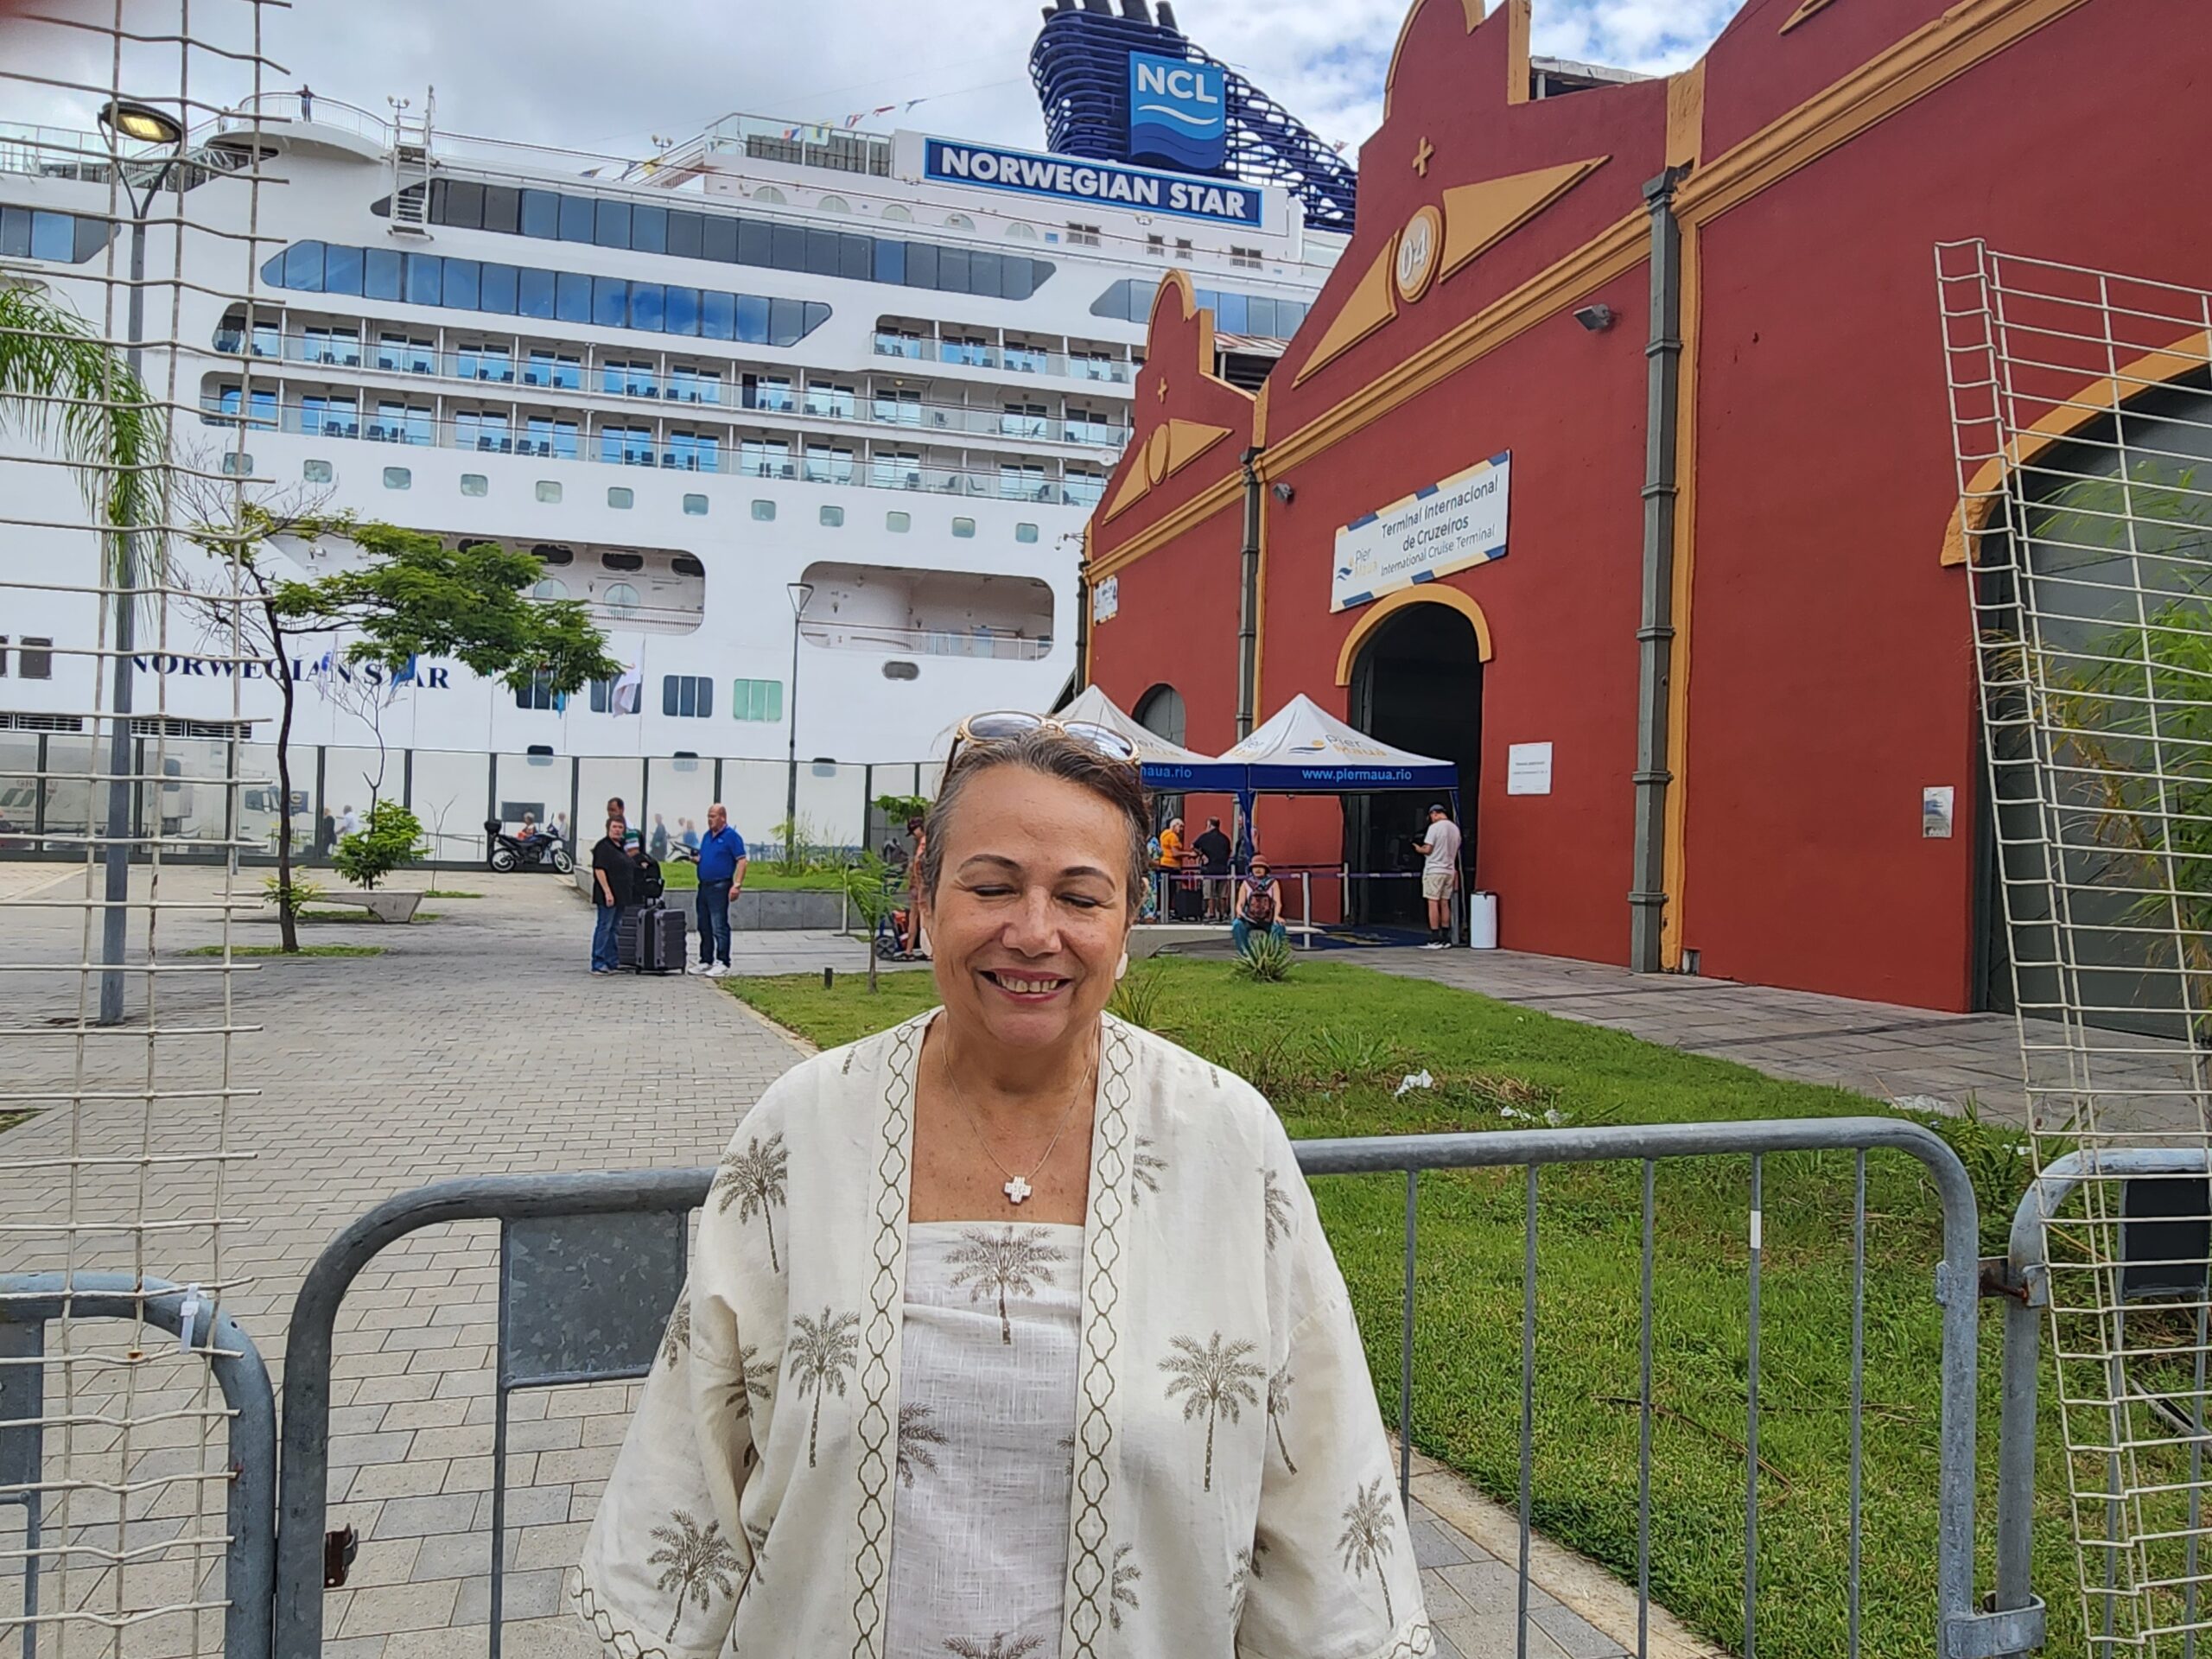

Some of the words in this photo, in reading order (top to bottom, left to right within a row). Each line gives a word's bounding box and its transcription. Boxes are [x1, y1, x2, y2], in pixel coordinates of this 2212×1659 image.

[1136, 62, 1219, 105] NCL
[941, 146, 1160, 206] NORWEGIAN
[1168, 181, 1246, 219] STAR
[1402, 226, 1428, 281] 04
[1382, 506, 1422, 539] Terminal
[1424, 474, 1498, 521] Internacional
[1380, 547, 1426, 577] International
[1427, 541, 1454, 559] Cruise
[1456, 523, 1496, 550] Terminal
[1402, 534, 1415, 552] de
[1417, 515, 1469, 545] Cruzeiros
[1325, 734, 1362, 747] Pier
[1301, 767, 1413, 783] www.piermaua.rio
